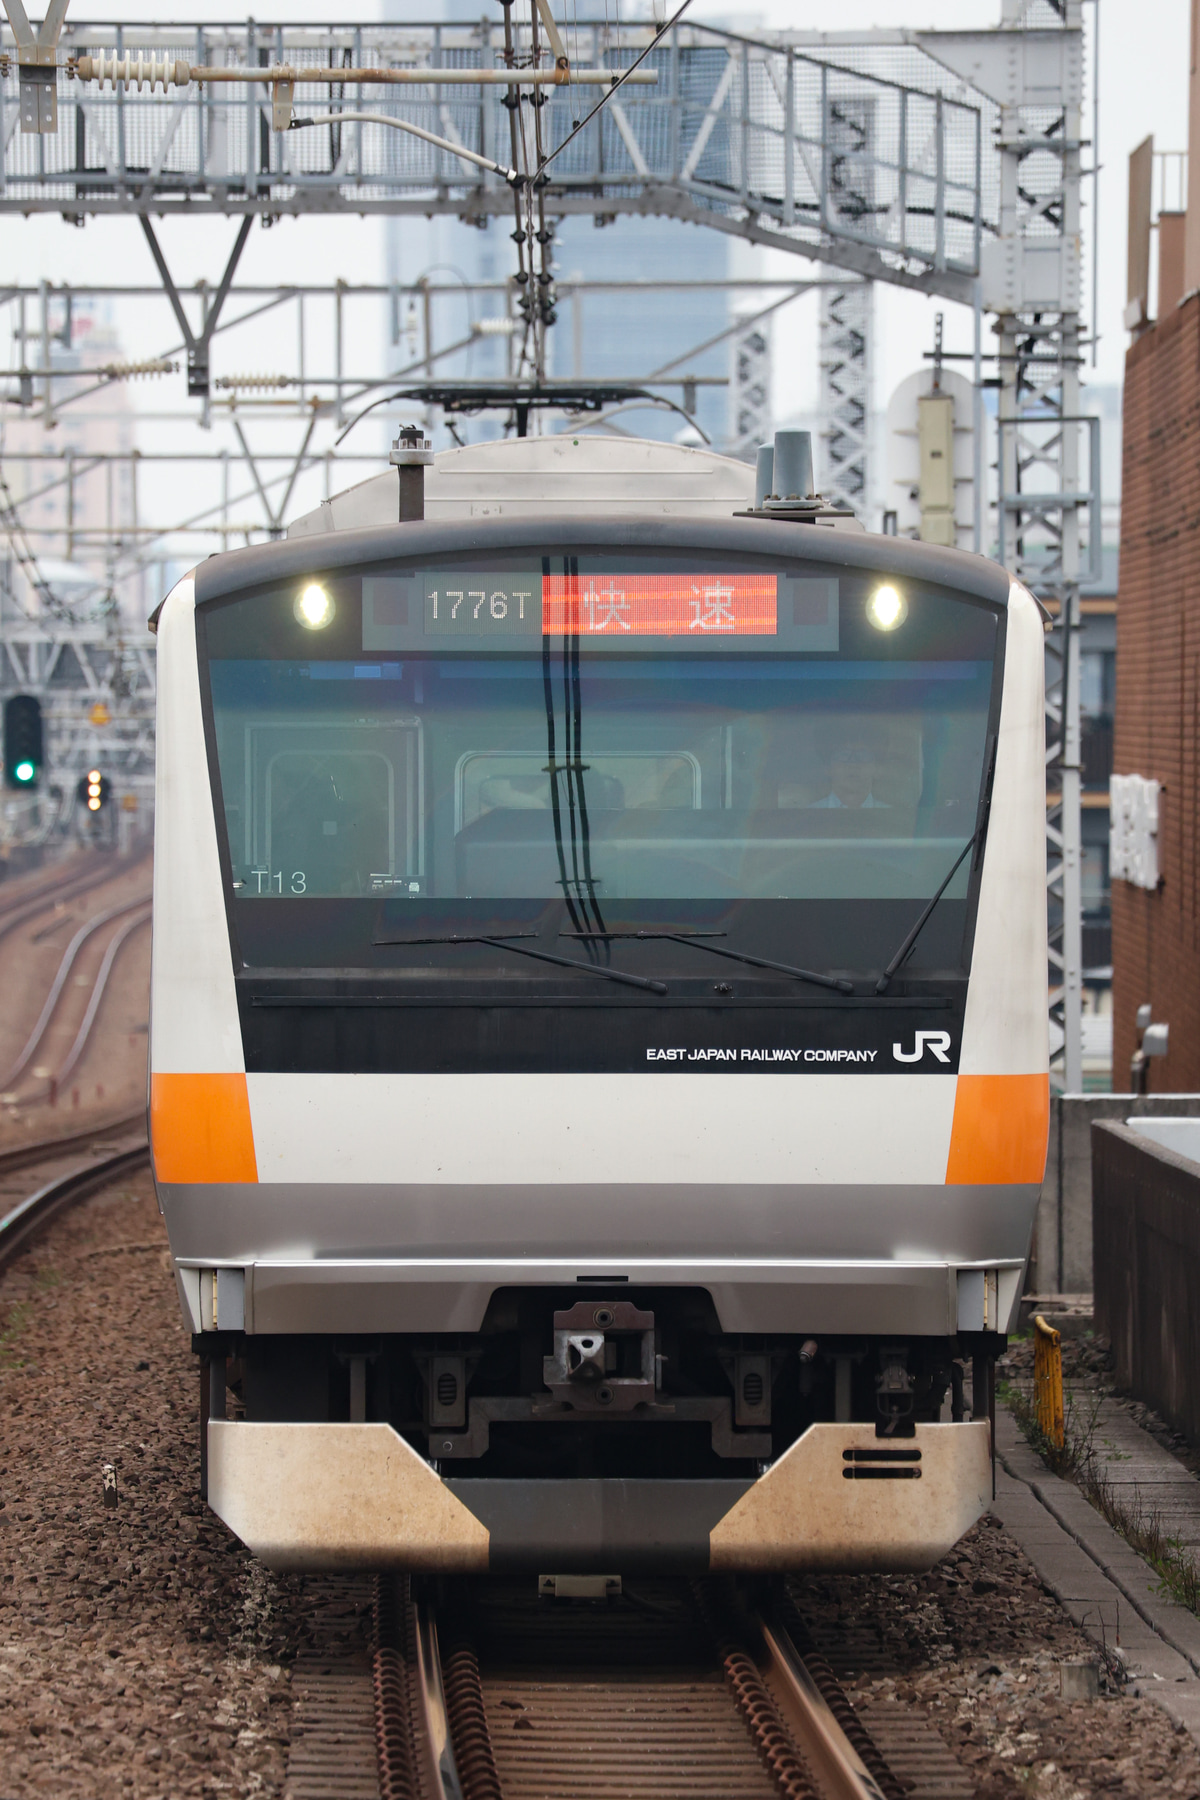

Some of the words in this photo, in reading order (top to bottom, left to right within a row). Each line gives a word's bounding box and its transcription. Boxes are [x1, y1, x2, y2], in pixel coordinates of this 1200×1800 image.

[427, 591, 532, 619] 1776T
[583, 580, 735, 631] 快速
[251, 871, 307, 894] T13
[646, 1048, 687, 1061] EAST
[687, 1048, 737, 1061] JAPAN
[740, 1049, 802, 1062] RAILWAY
[803, 1050, 878, 1062] COMPANY
[892, 1030, 951, 1063] JR
